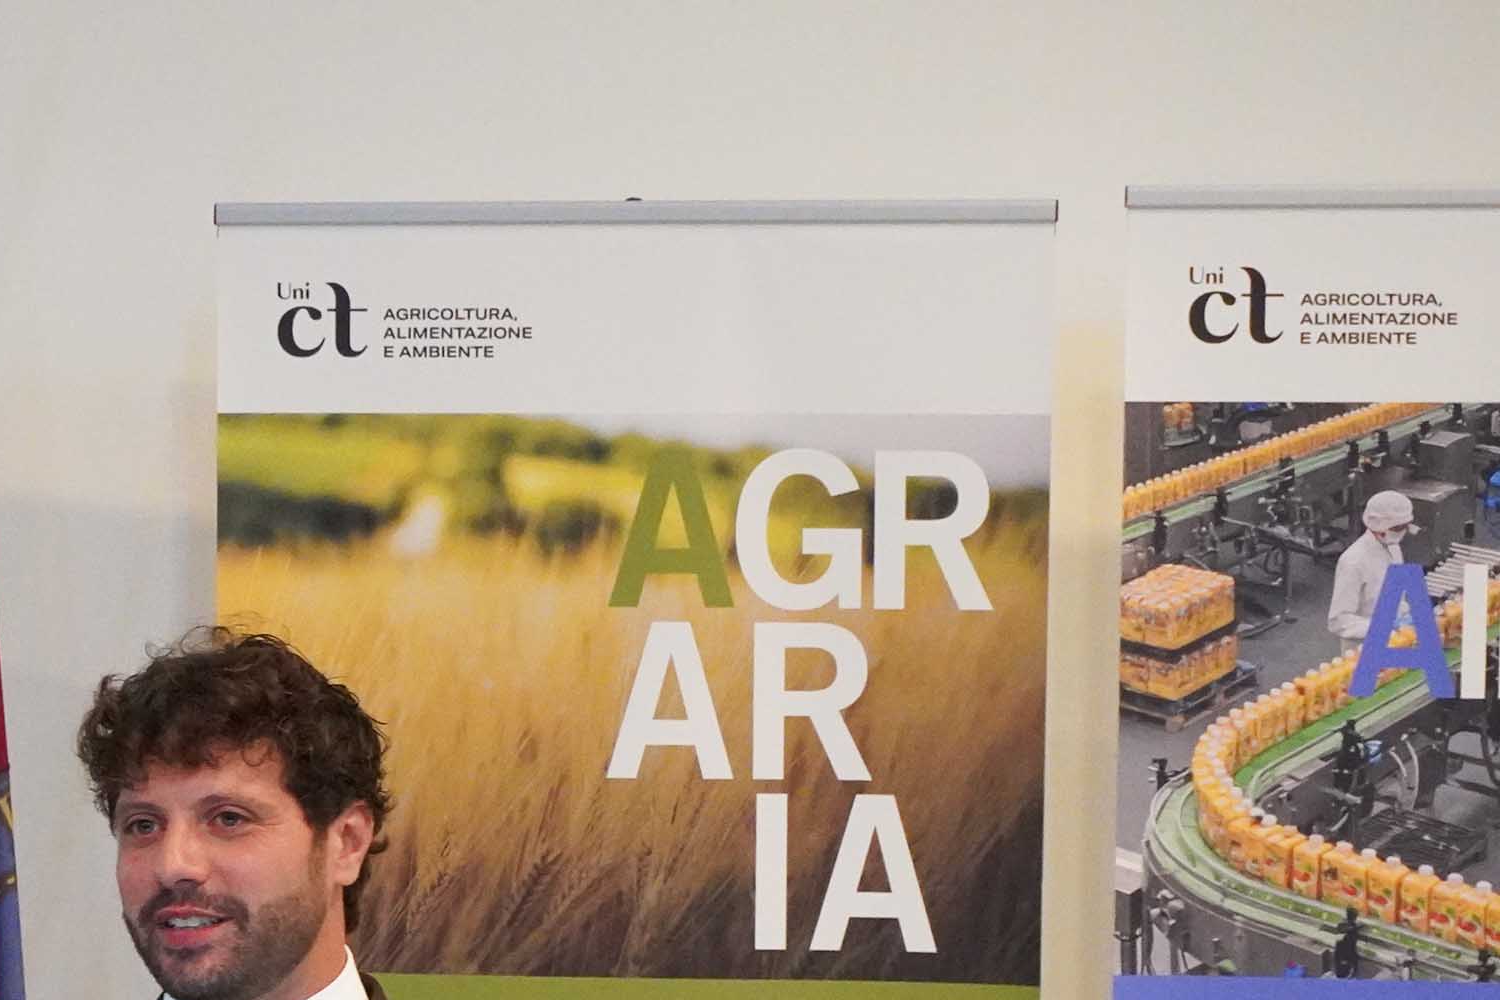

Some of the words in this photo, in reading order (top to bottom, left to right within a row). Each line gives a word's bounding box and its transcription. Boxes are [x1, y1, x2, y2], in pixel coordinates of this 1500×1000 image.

[1189, 266, 1224, 284] Uni
[277, 281, 310, 300] Uni
[1189, 267, 1284, 344] ct
[1300, 293, 1442, 307] AGRICOLTURA,
[277, 282, 368, 358] ct
[383, 307, 518, 322] AGRICOLTURA,
[1300, 312, 1458, 326] ALIMENTAZIONE
[383, 326, 533, 340] ALIMENTAZIONE
[1300, 332, 1311, 345] E
[1316, 332, 1417, 345] AMBIENTE
[383, 346, 394, 359] E
[399, 346, 495, 359] AMBIENTE
[608, 448, 994, 611] AGR
[606, 621, 873, 782] AR
[754, 792, 938, 954] IA
